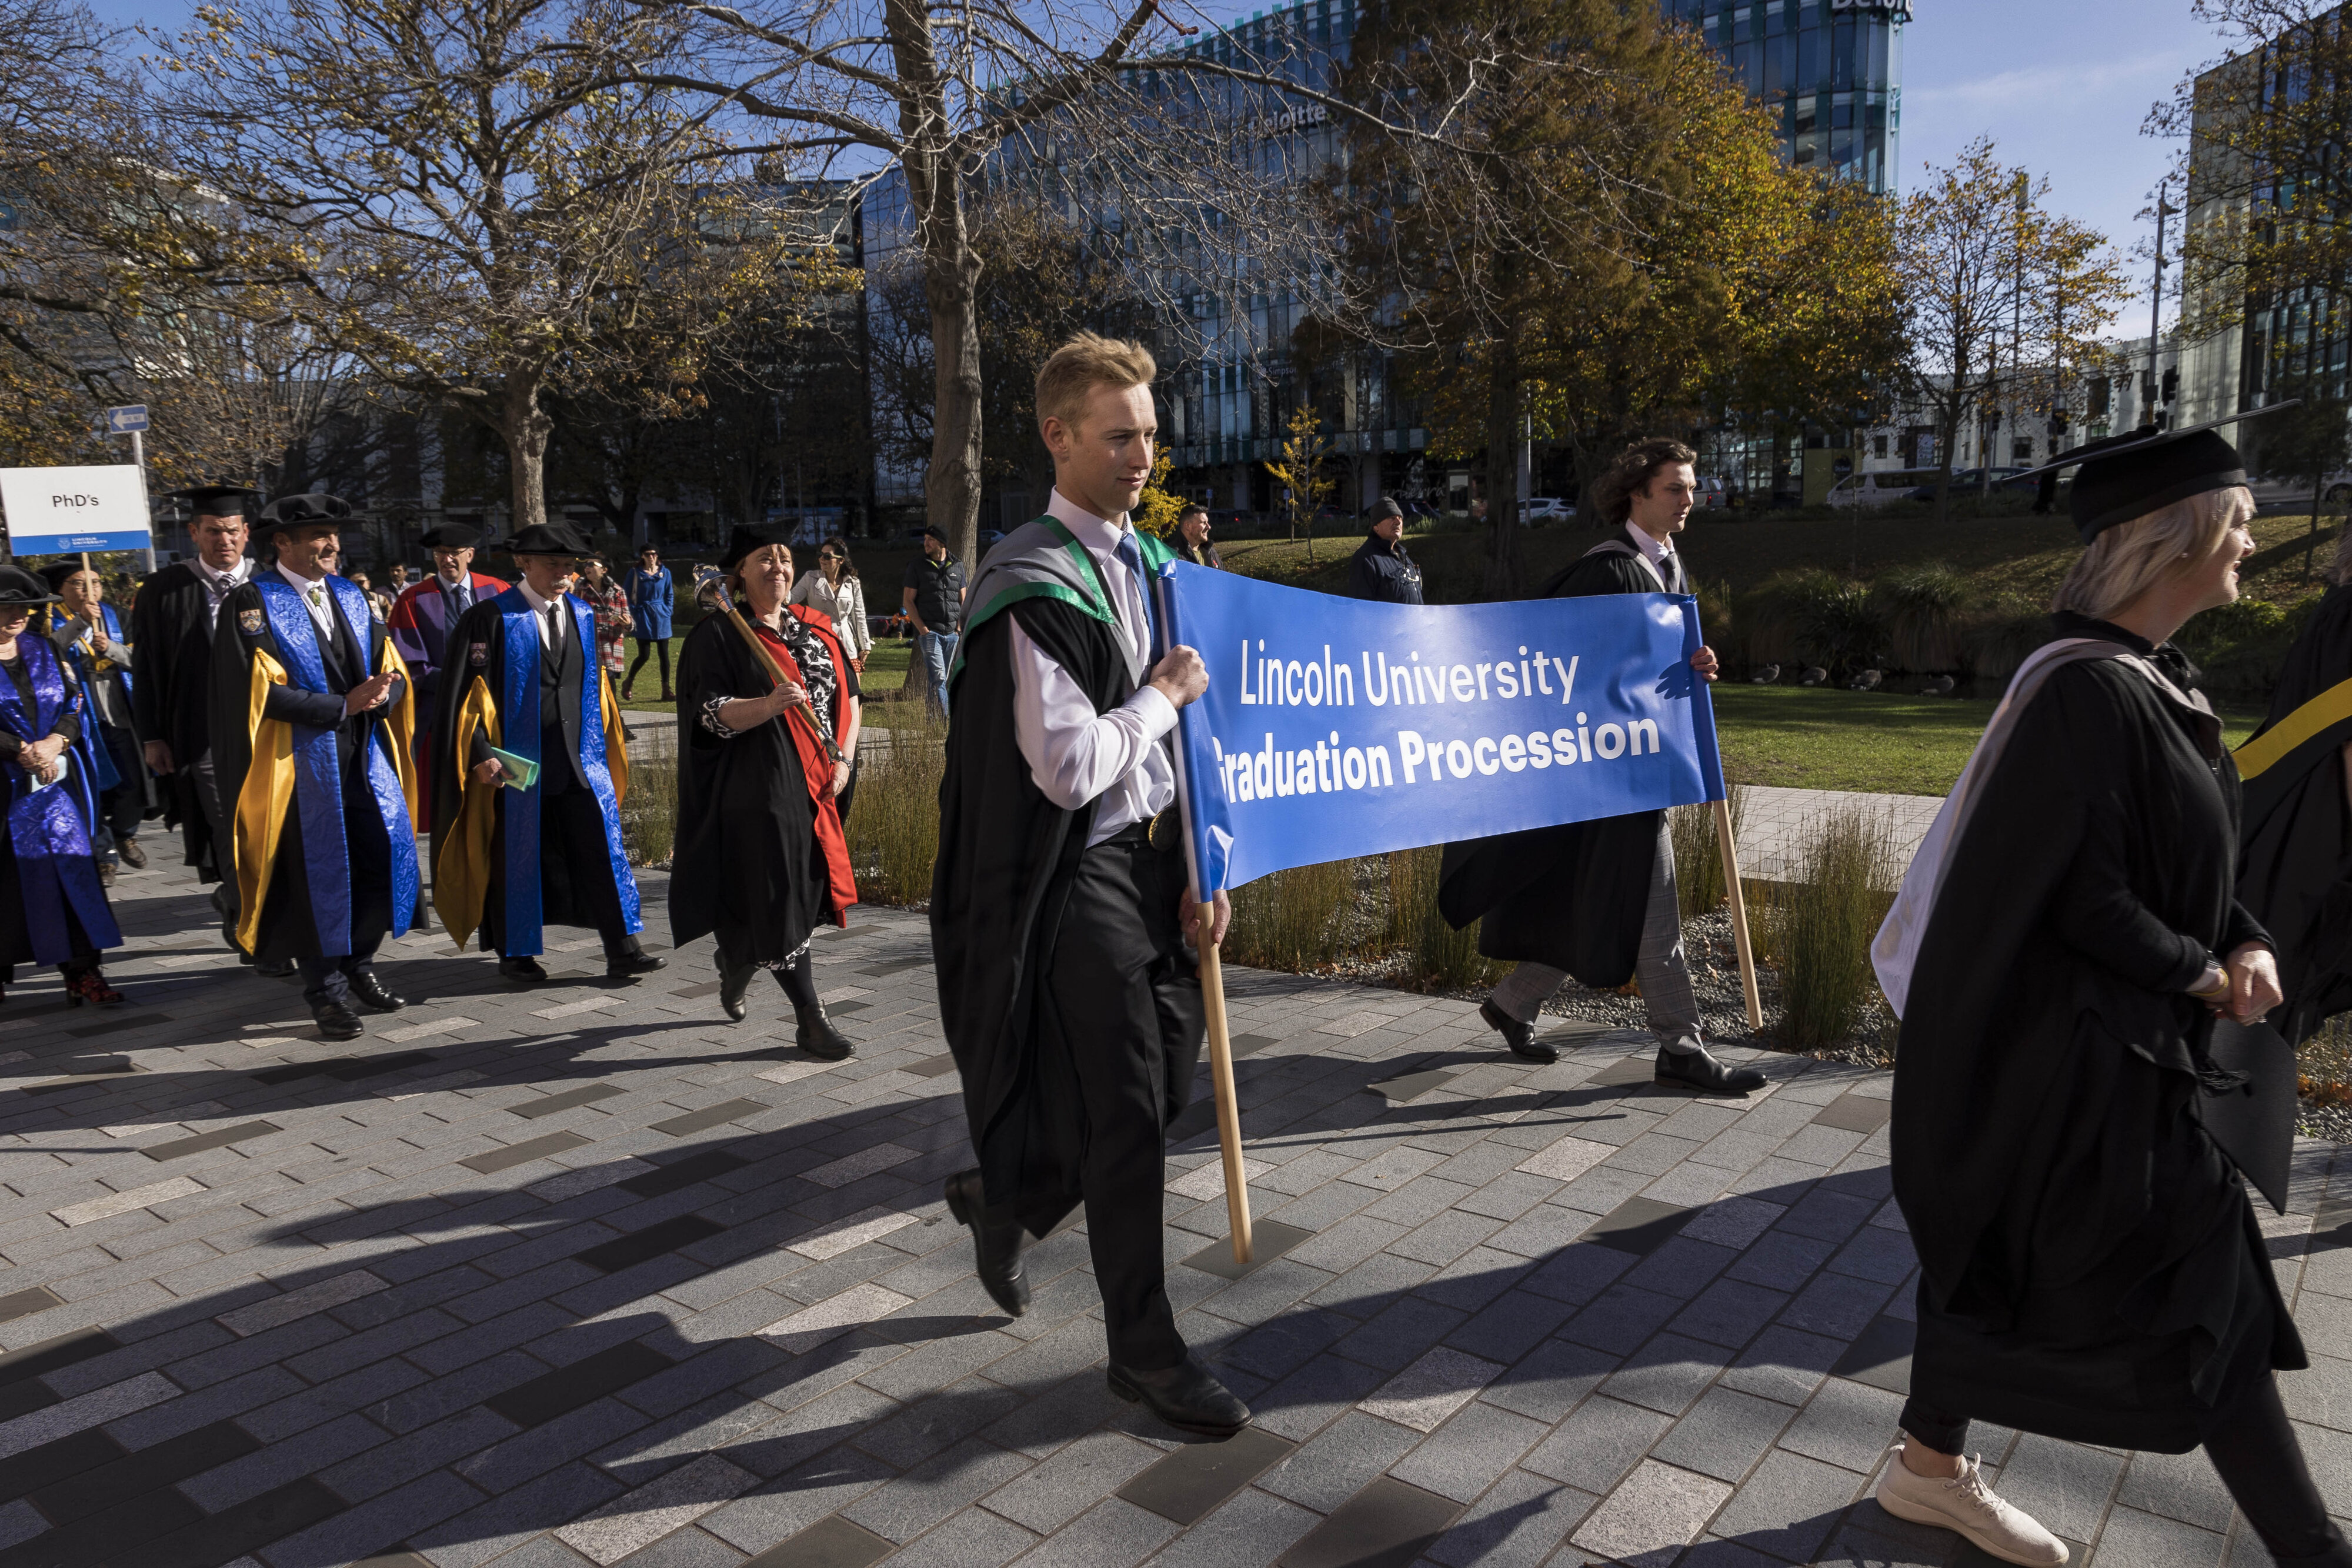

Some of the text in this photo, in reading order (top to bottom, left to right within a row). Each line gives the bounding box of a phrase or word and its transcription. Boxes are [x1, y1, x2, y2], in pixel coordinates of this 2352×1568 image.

[52, 495, 99, 507] PhD's
[1240, 639, 1580, 706] Lincoln University
[1397, 712, 1660, 784] Procession
